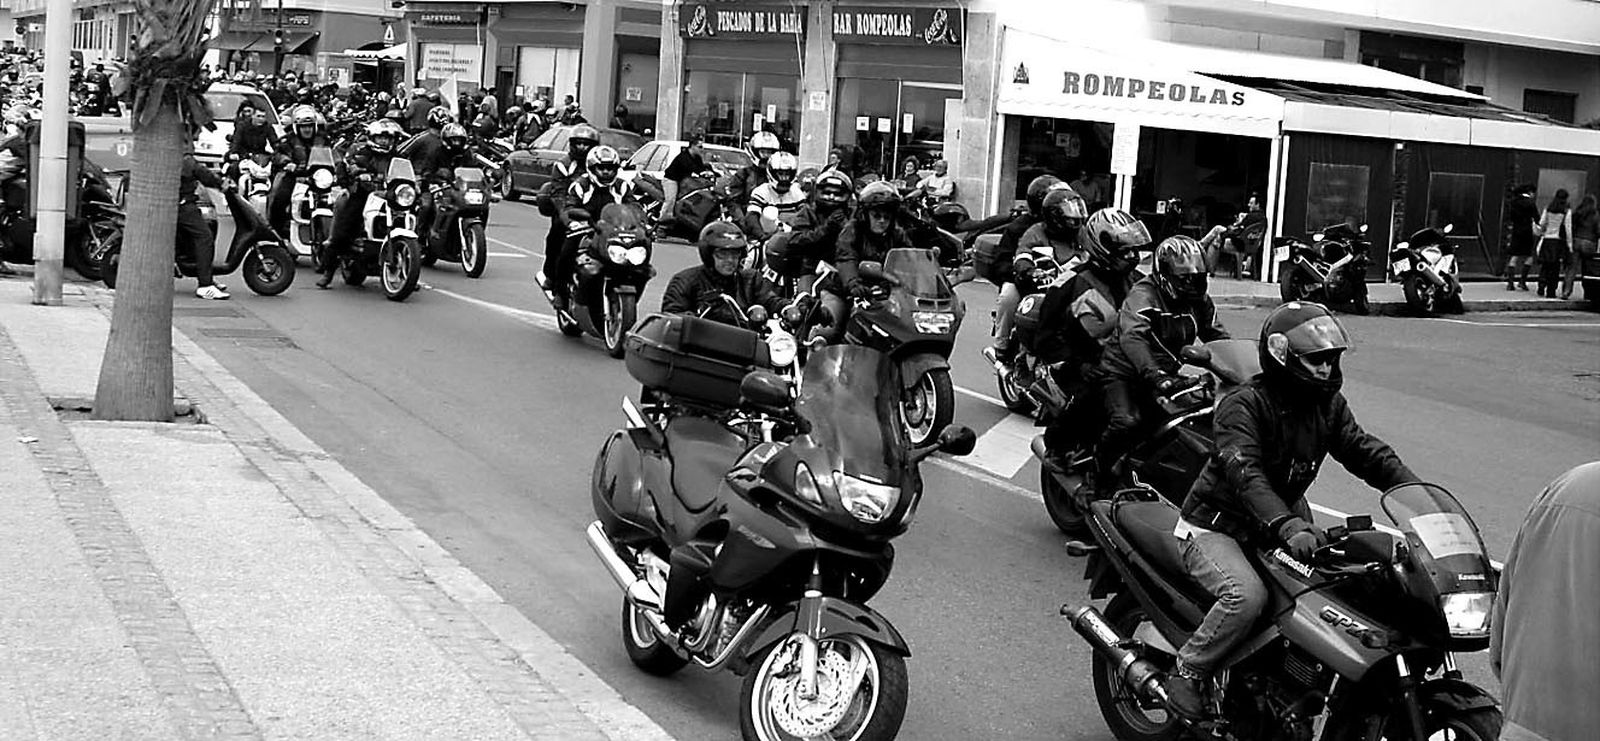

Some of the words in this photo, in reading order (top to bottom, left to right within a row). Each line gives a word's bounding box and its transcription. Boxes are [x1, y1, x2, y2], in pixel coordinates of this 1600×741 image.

[717, 11, 752, 33] PESCADOS
[755, 12, 765, 33] DE
[768, 12, 777, 33] LA
[833, 13, 853, 35] BAR
[856, 13, 912, 37] ROMPEOLAS
[1062, 71, 1245, 106] ROMPEOLAS
[1273, 547, 1315, 579] Kawasaki
